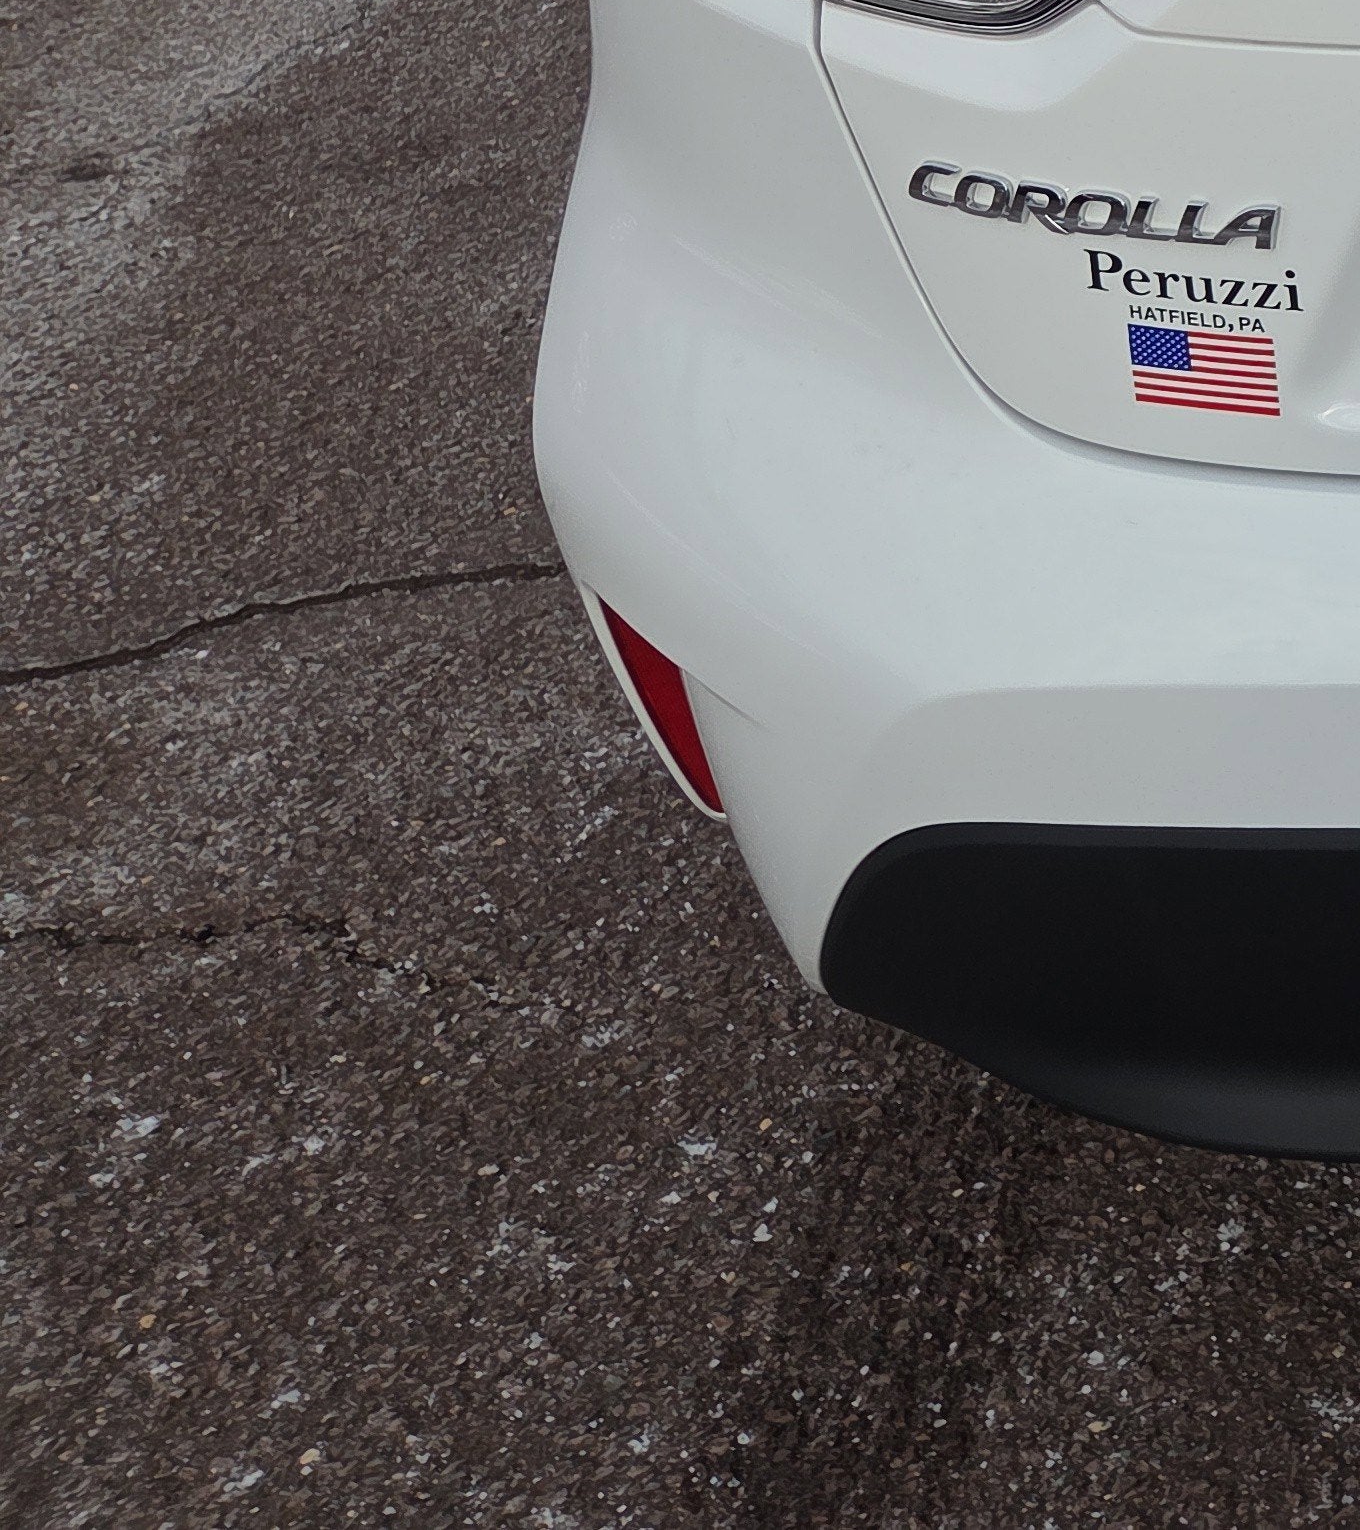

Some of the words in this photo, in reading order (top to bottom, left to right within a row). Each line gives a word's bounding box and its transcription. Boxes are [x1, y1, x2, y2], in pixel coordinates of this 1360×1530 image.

[908, 160, 1282, 250] COROLLA
[1083, 248, 1304, 312] Peruzzi
[1129, 304, 1234, 333] HATFIELD,
[1239, 316, 1266, 333] PA
